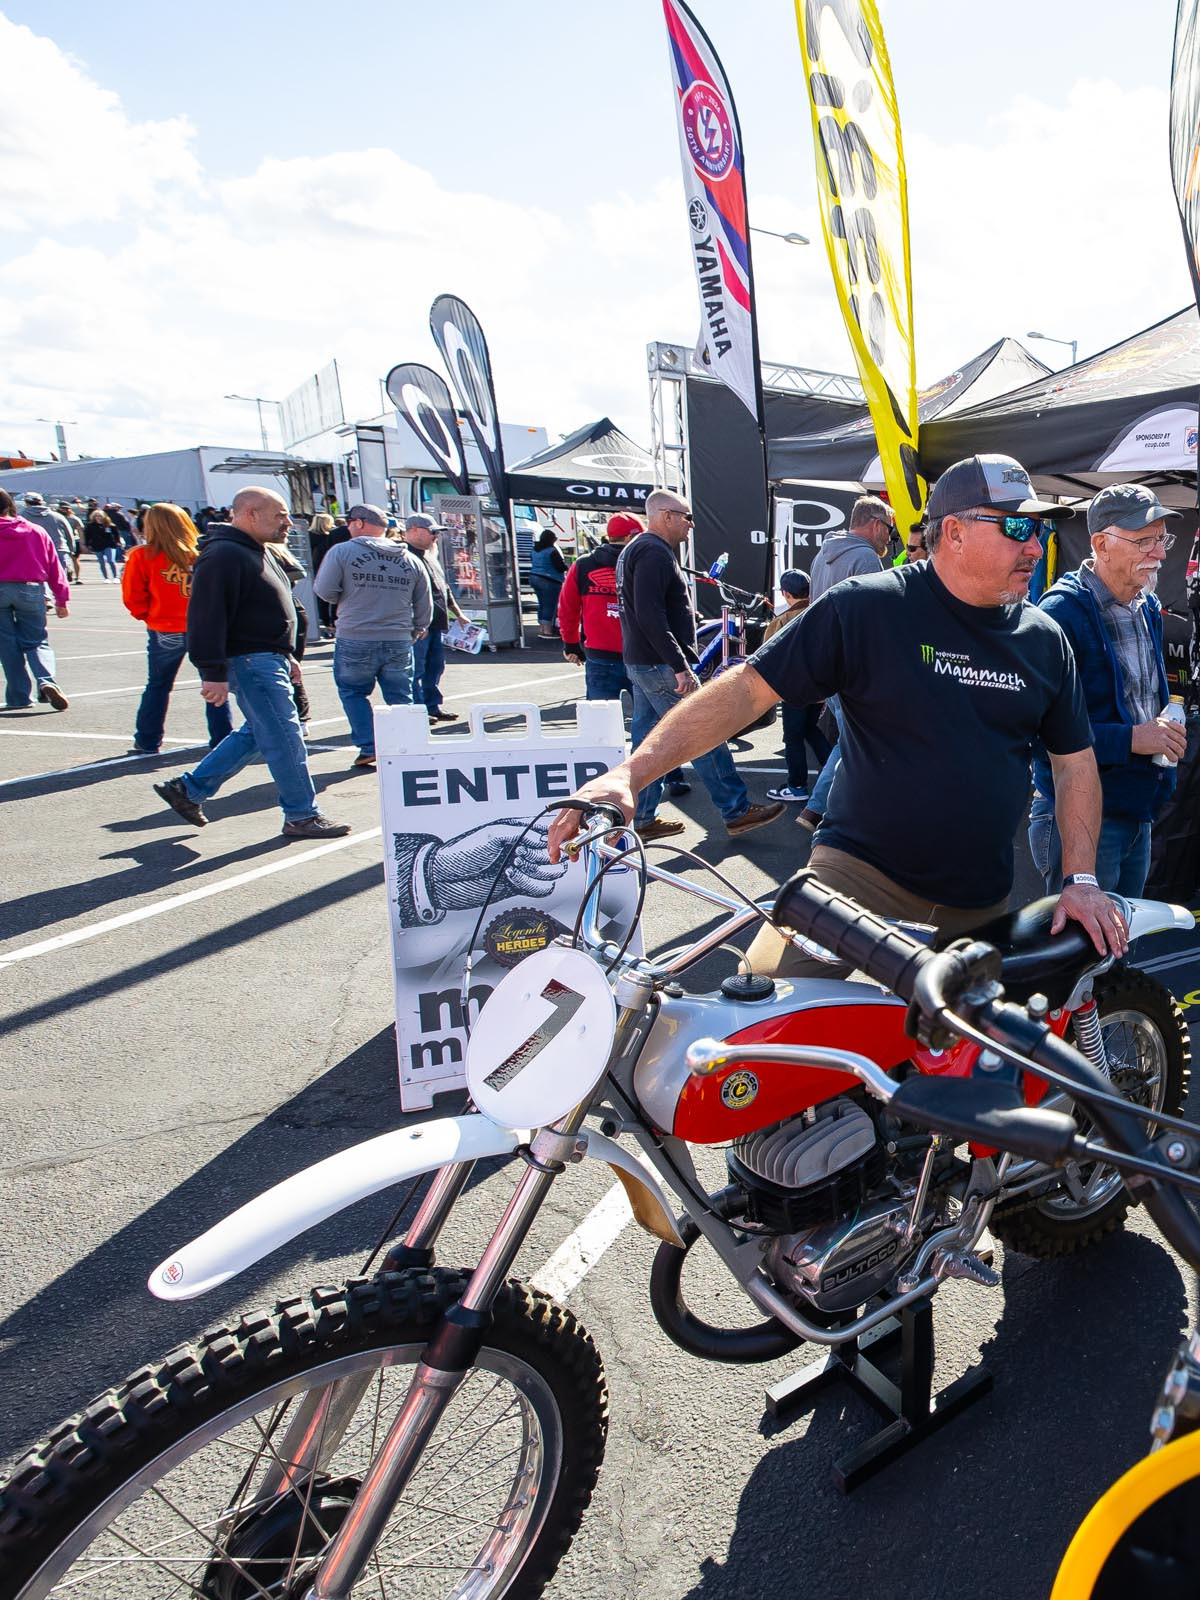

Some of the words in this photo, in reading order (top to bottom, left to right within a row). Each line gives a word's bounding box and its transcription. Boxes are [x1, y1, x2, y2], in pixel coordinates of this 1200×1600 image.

[694, 235, 733, 359] YAMAHA
[352, 552, 412, 574] FASTHOUSE
[352, 573, 384, 583] SPEED
[934, 659, 1027, 688] Mammoth
[958, 678, 1021, 692] MOTOCROSS
[491, 920, 549, 940] Legends
[497, 937, 546, 952] HEROES
[483, 978, 586, 1092] 7
[723, 1072, 758, 1099] BULTACO
[823, 1240, 897, 1292] BULTACO
